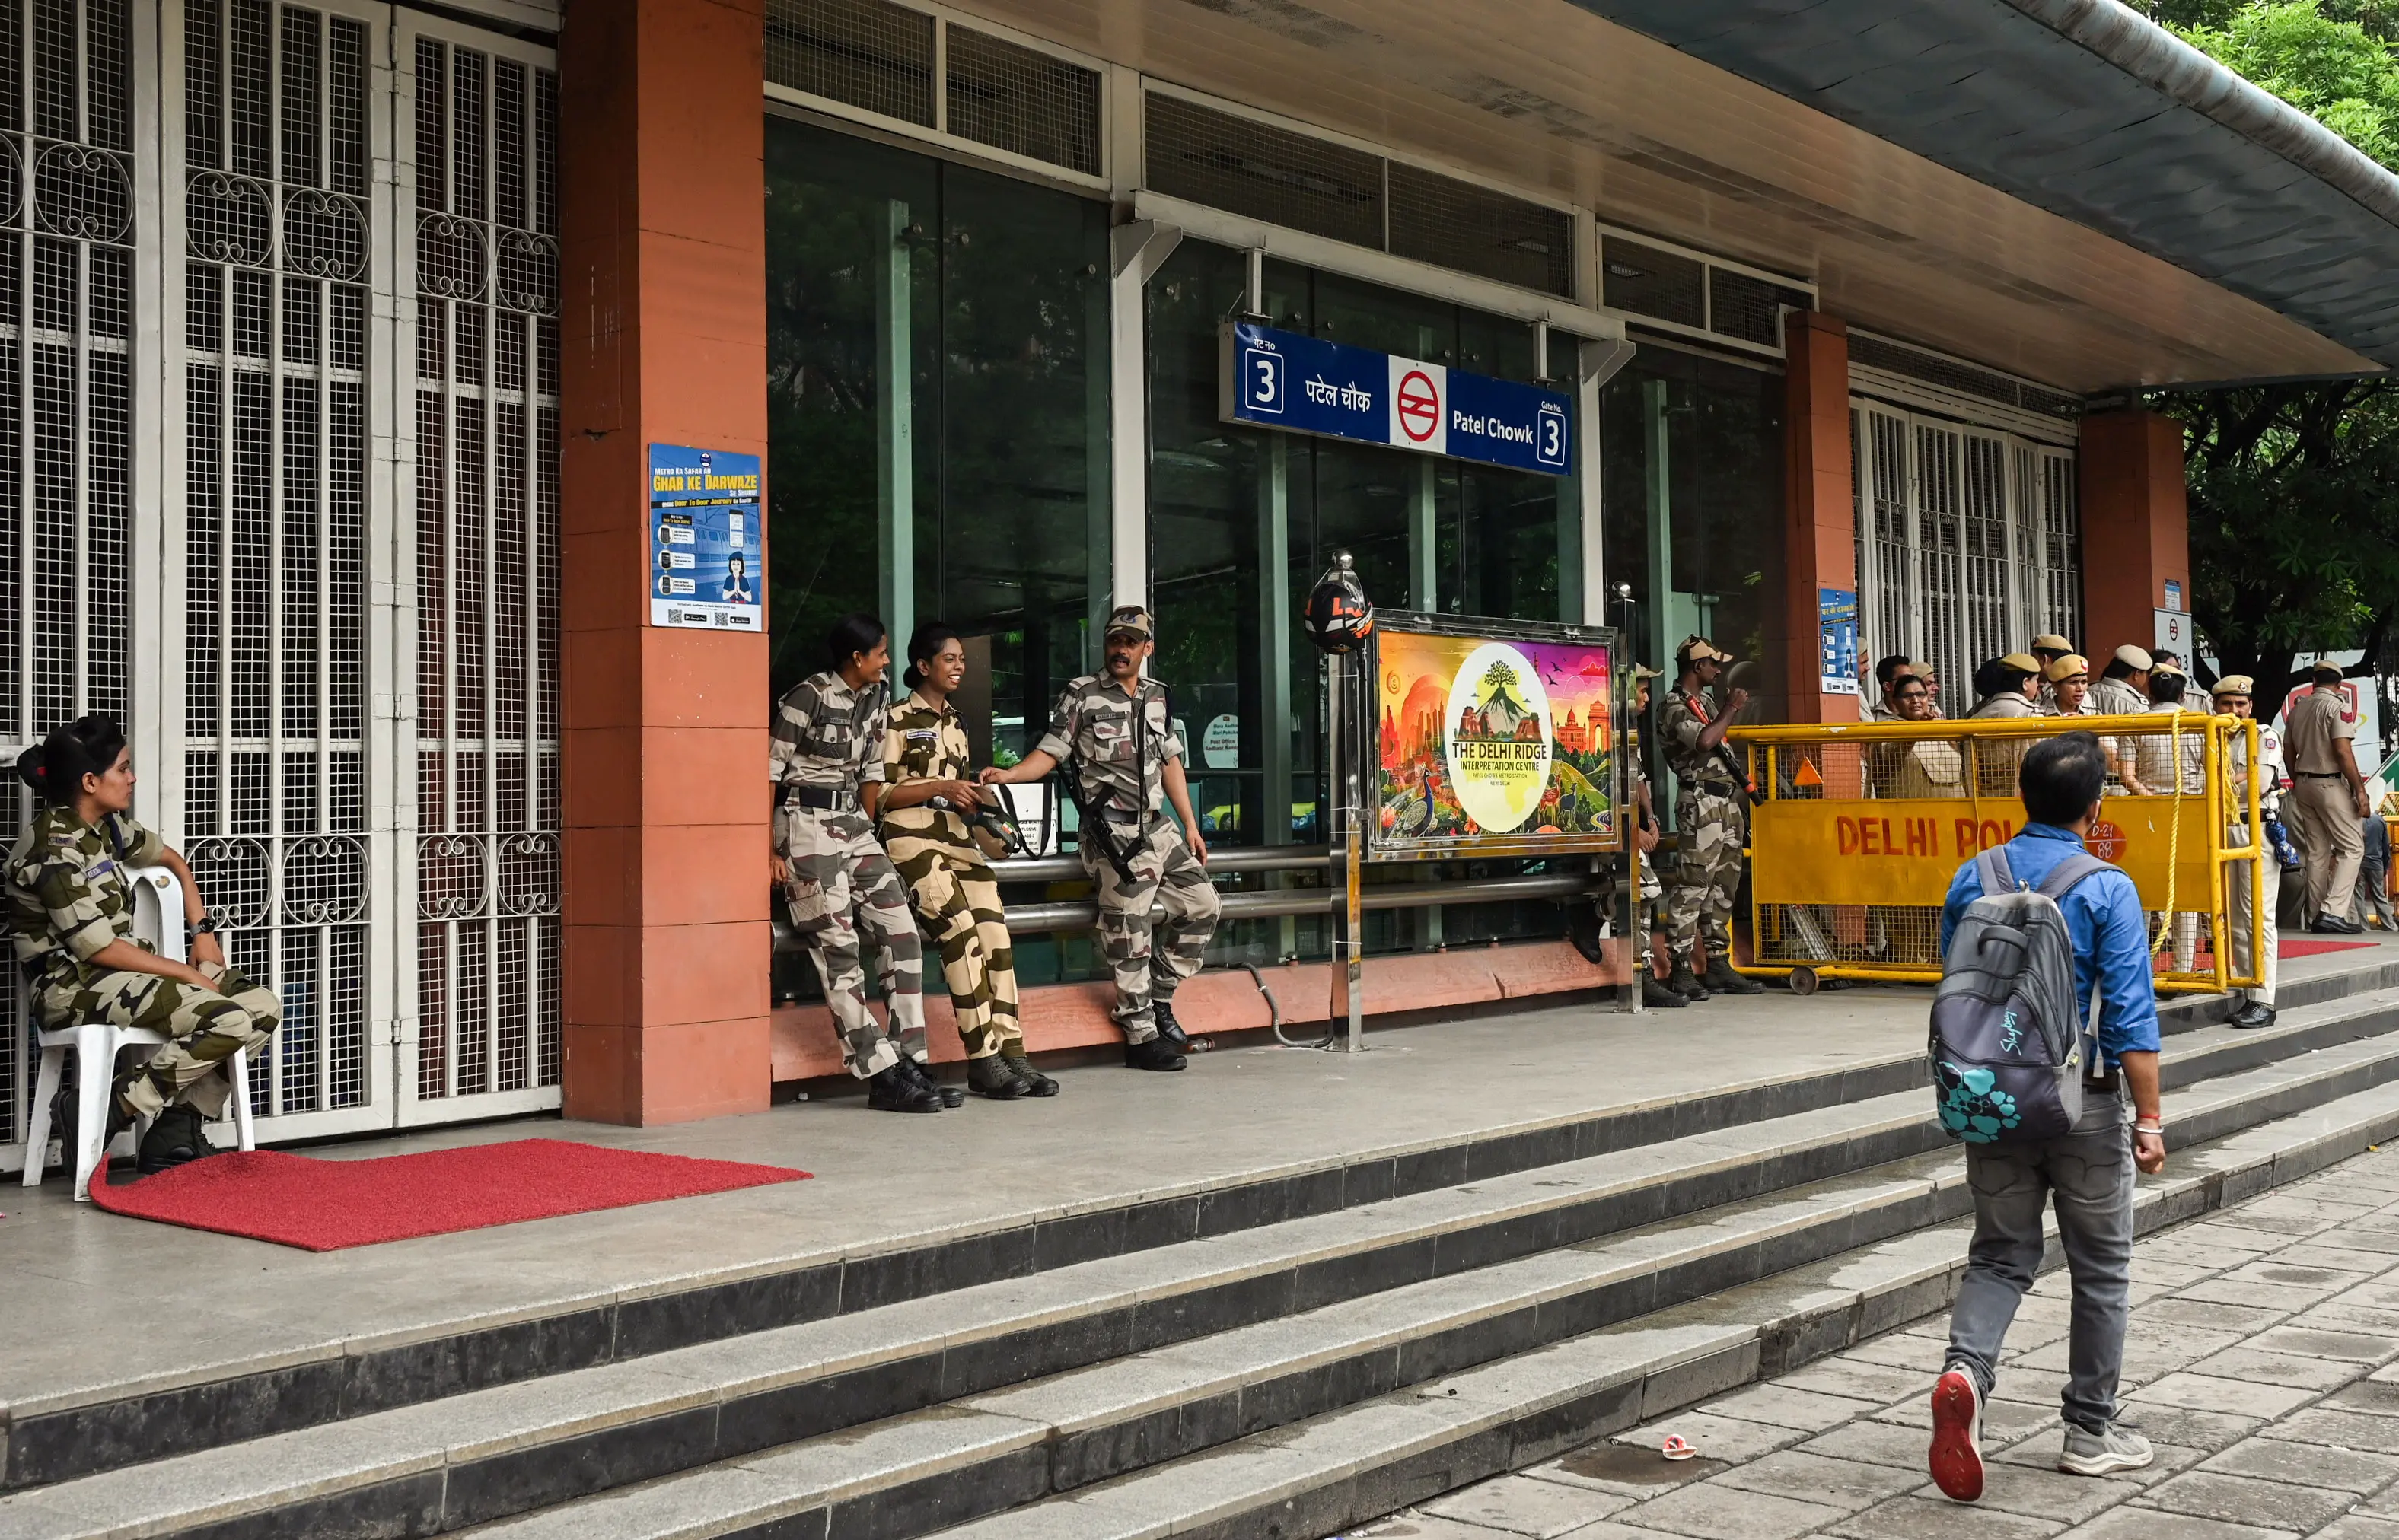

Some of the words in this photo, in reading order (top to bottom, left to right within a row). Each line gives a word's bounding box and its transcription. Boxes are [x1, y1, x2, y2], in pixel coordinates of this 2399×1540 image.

[1254, 334, 1264, 349] गेट
[1255, 360, 1276, 403] 3
[1305, 373, 1338, 407] पटेल
[1340, 380, 1372, 412] चौक
[1541, 400, 1553, 412] Gate
[1553, 403, 1562, 413] No.
[1453, 410, 1486, 434] Patel
[1487, 418, 1534, 444] Chowk
[1544, 419, 1559, 457] 3
[653, 475, 684, 492] GHAR
[687, 476, 702, 491] KE
[705, 474, 757, 490] DARWAZE
[2184, 654, 2188, 671] 3
[1452, 743, 1475, 759] THE
[1478, 743, 1511, 759] DELHI
[1515, 744, 1547, 760] RIDGE
[1460, 760, 1514, 771] INTERPRETATION
[1515, 762, 1540, 772] CENTRE
[1837, 816, 1939, 857] DELHI
[2092, 824, 2114, 838] D-21
[2097, 841, 2113, 859] 88
